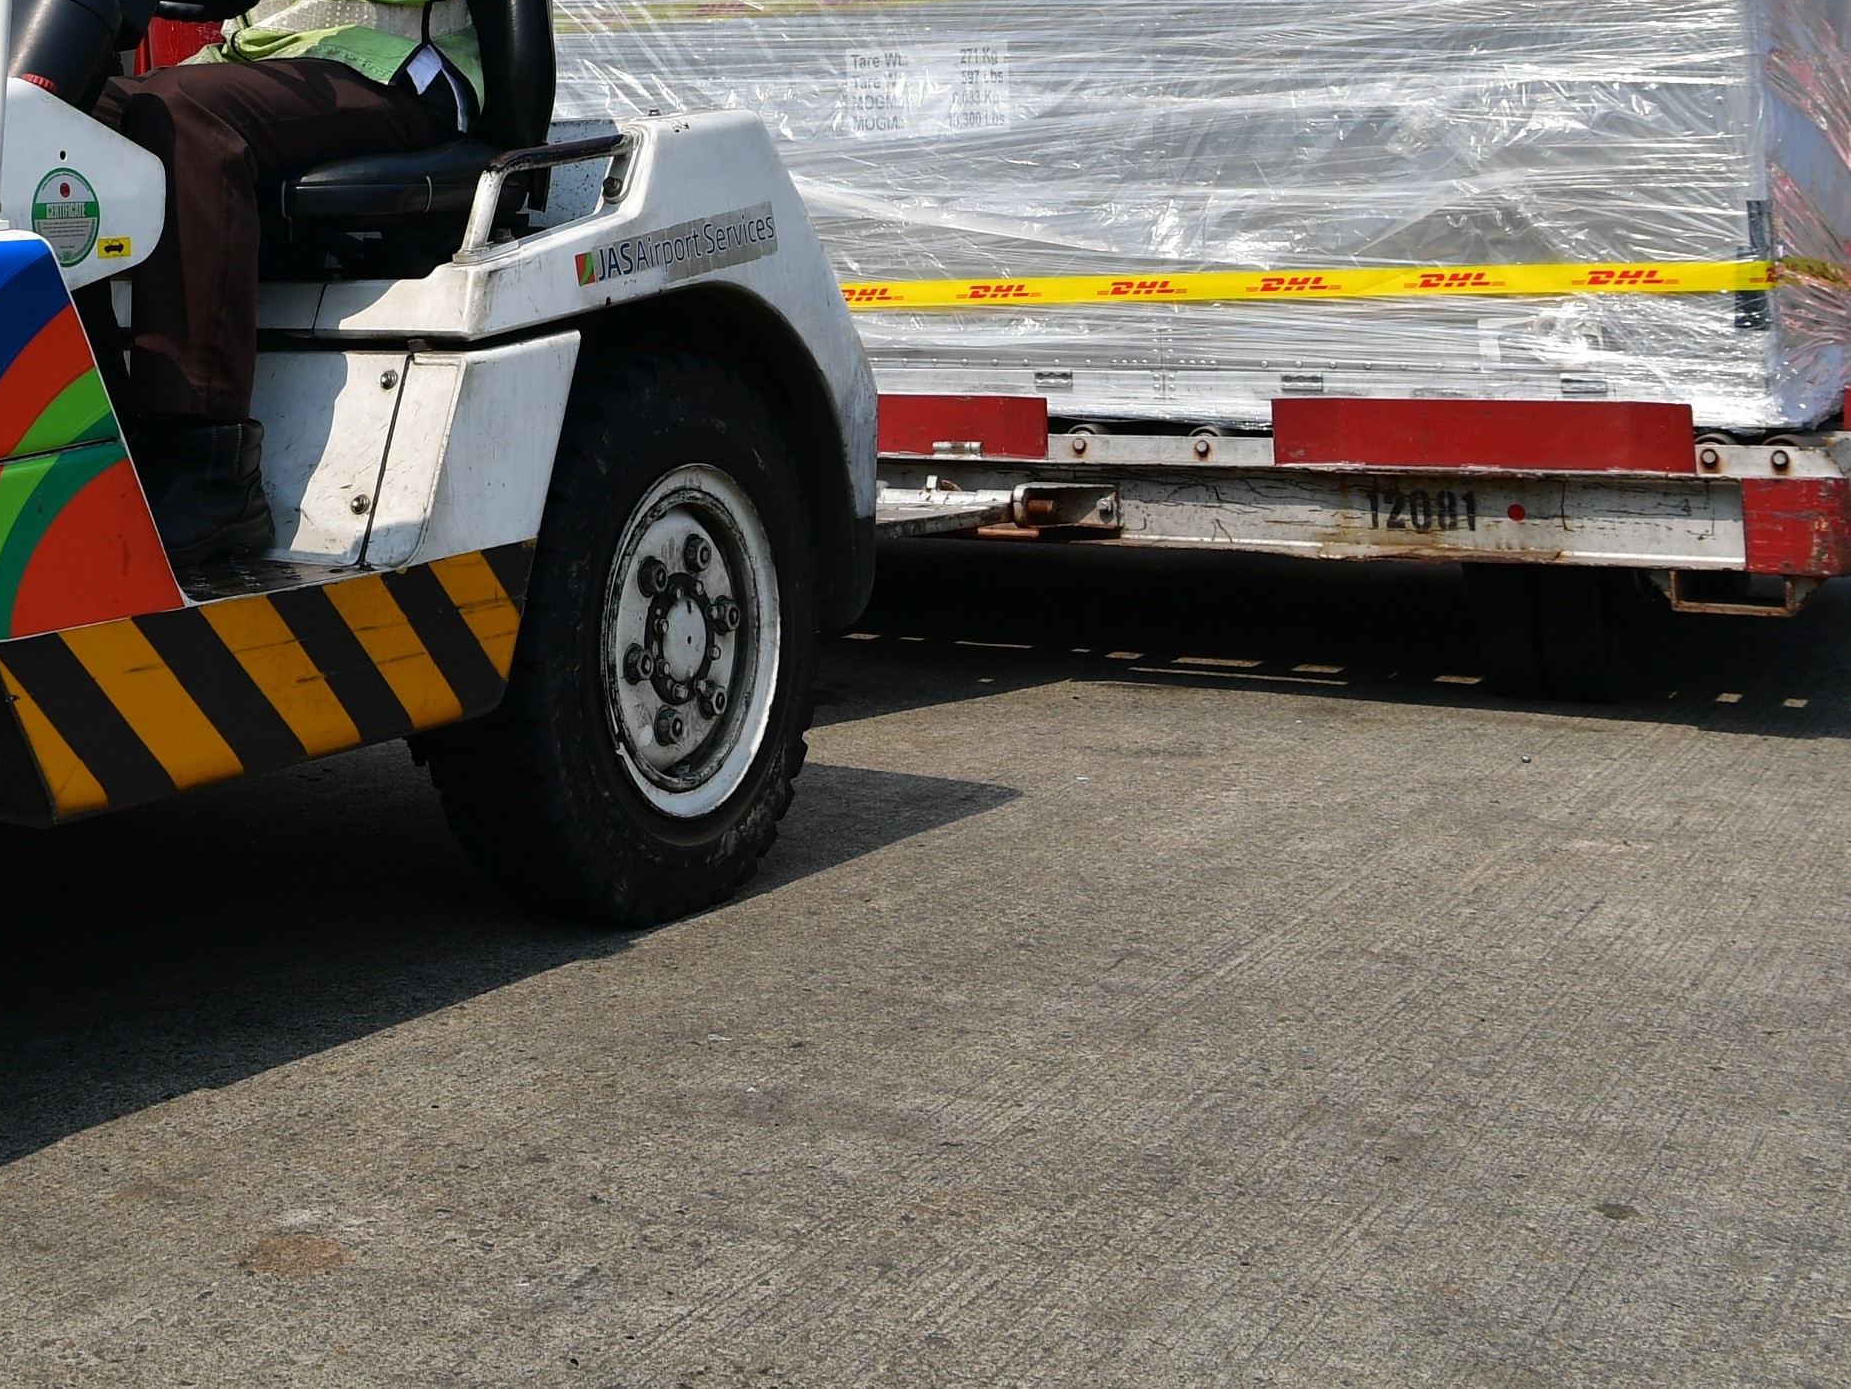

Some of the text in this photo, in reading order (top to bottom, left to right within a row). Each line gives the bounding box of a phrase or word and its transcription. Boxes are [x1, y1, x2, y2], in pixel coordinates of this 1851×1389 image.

[851, 53, 880, 69] Tare
[960, 47, 998, 66] 271 Kg
[852, 74, 880, 89] Tare
[961, 69, 980, 85] 597
[985, 111, 1005, 127] Lbs
[46, 202, 86, 219] CERTIFICATE
[598, 214, 776, 282] JAS Airport Services
[842, 270, 1667, 302] DHL DHL DHL DHL DHL DHL
[1365, 488, 1477, 532] 12081
